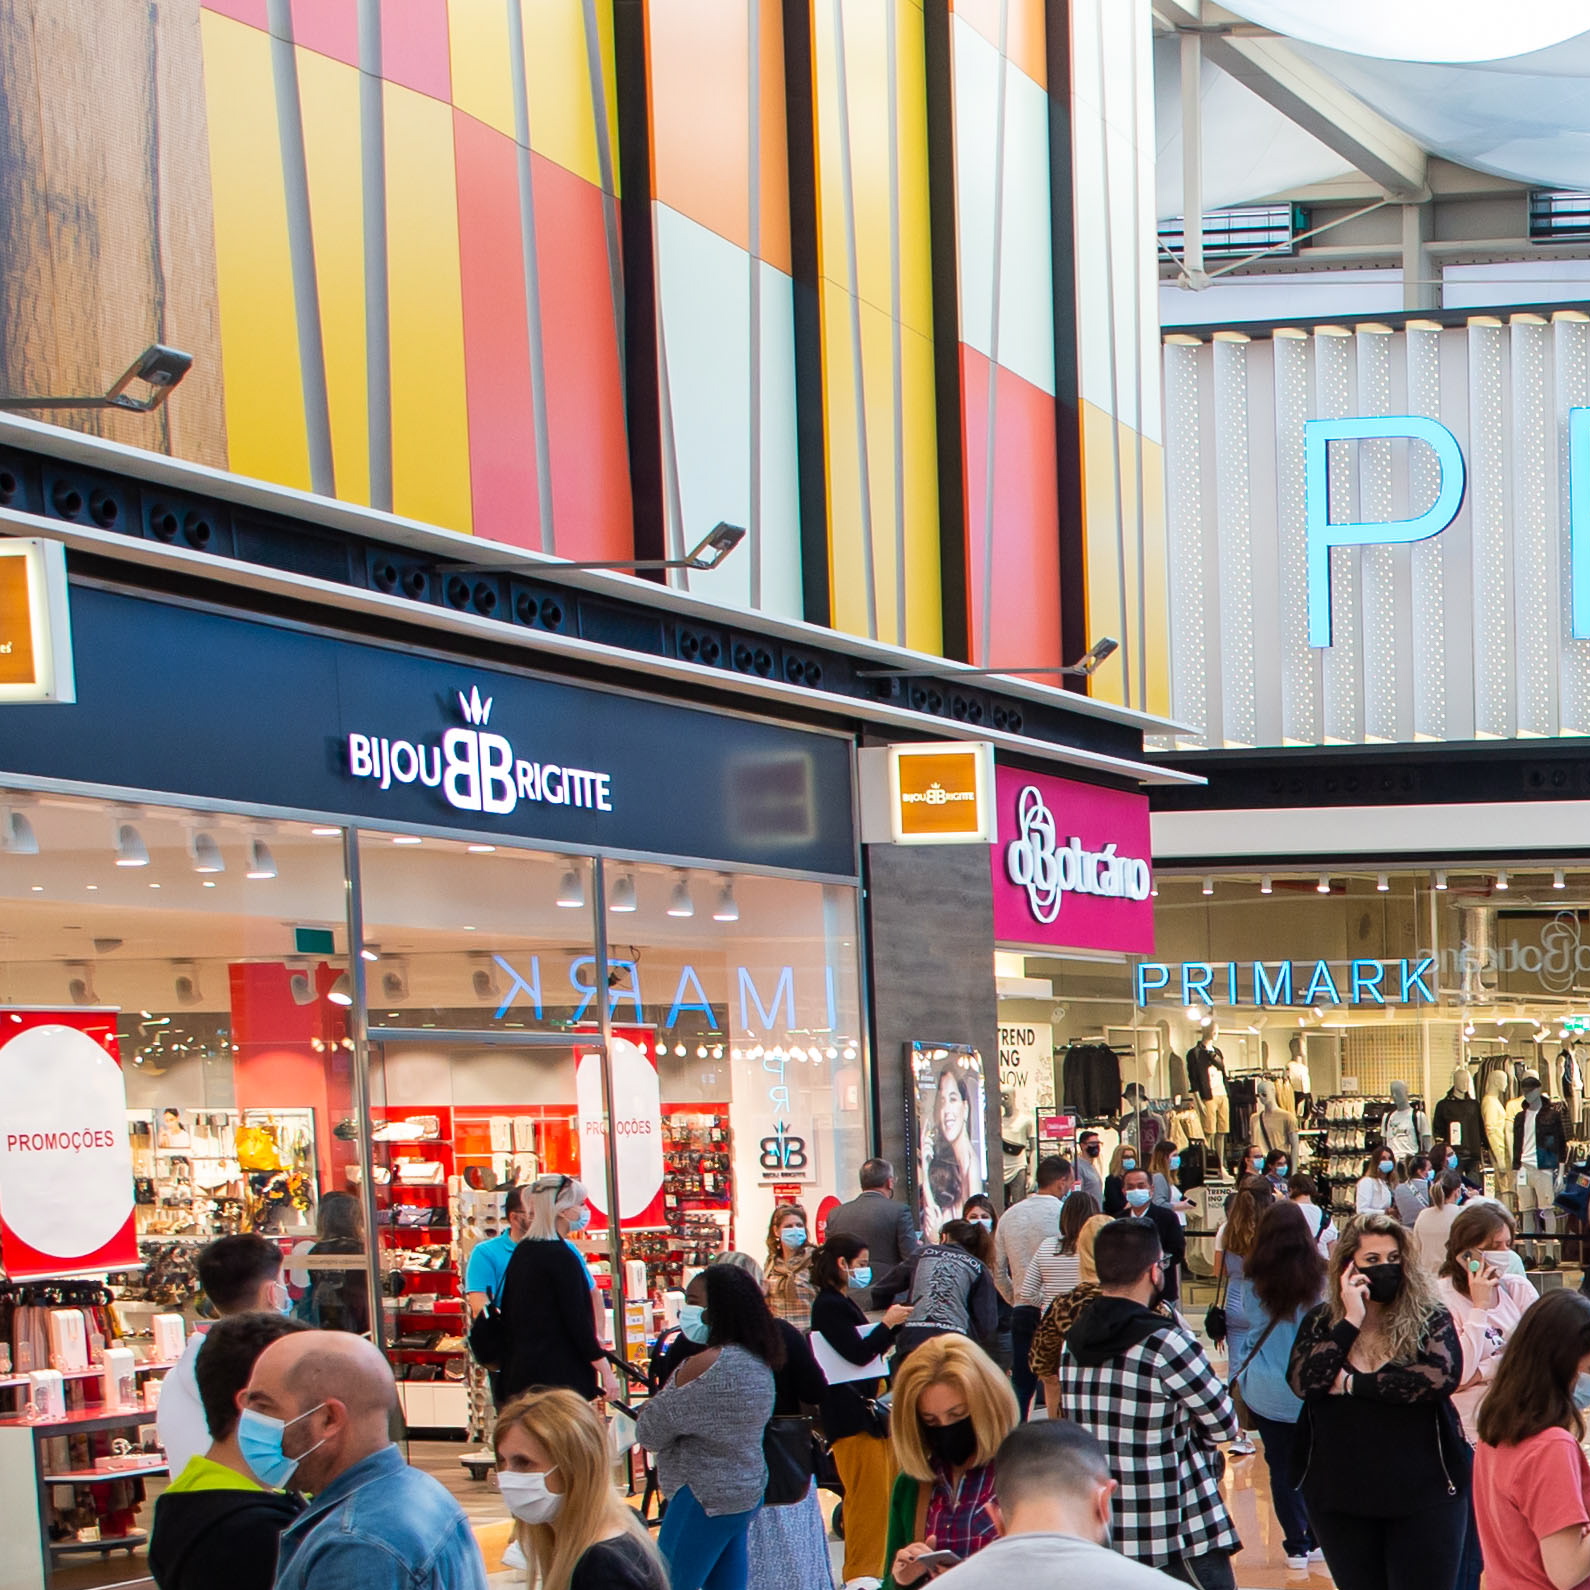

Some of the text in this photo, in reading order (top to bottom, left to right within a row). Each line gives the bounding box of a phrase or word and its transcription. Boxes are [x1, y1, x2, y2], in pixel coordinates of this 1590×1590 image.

[1137, 959, 1436, 1007] PRIMARK
[1000, 1050, 1020, 1066] NG
[586, 1118, 651, 1138] PROOÇÕES
[7, 1127, 115, 1153] PROMOÇÕES
